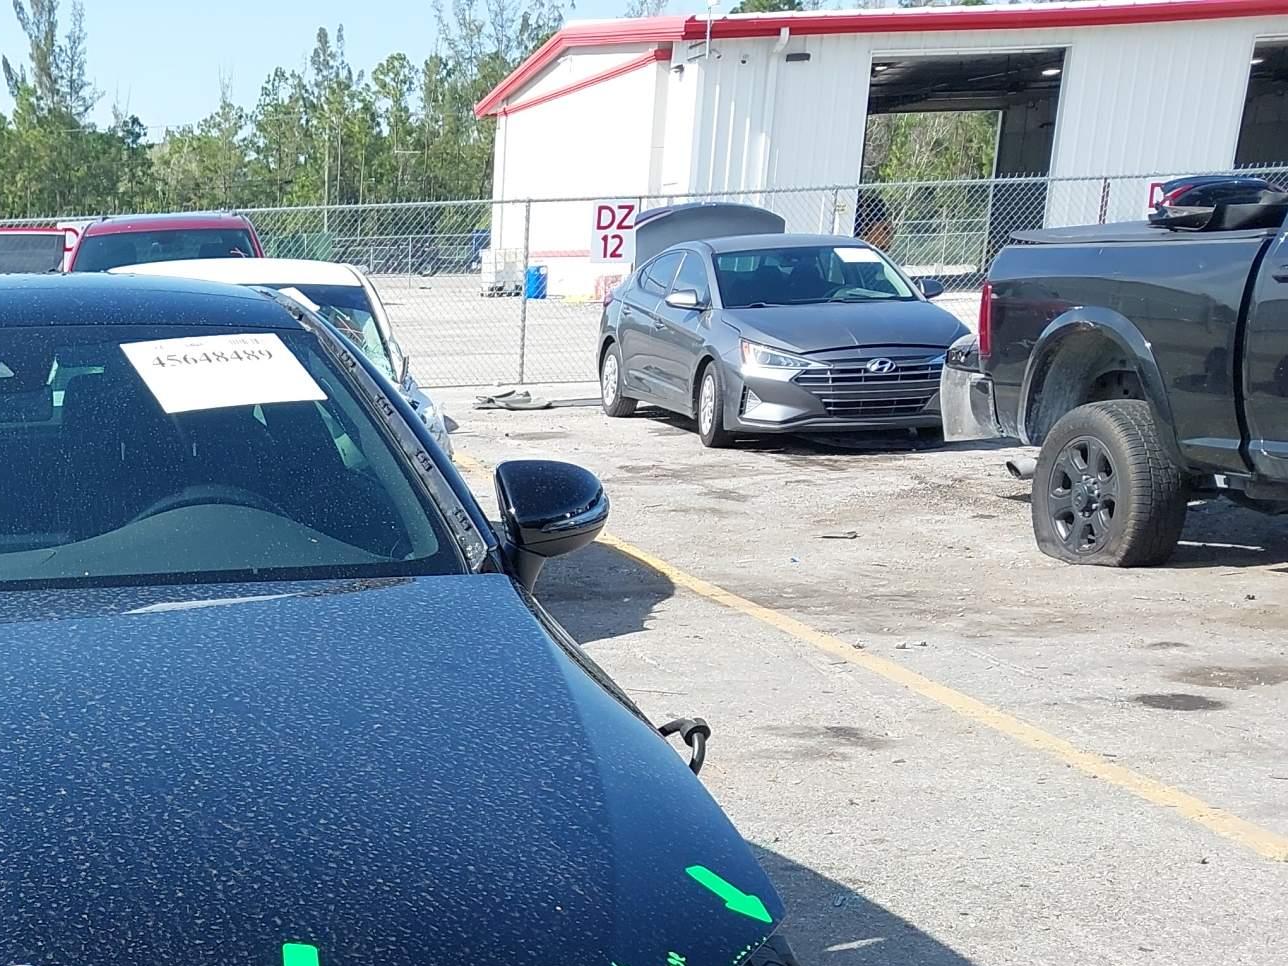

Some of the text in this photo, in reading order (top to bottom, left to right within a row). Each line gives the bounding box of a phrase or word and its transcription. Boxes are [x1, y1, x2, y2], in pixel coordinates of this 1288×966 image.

[596, 204, 635, 231] DZ
[600, 233, 624, 259] 12
[152, 348, 274, 368] 45648489
